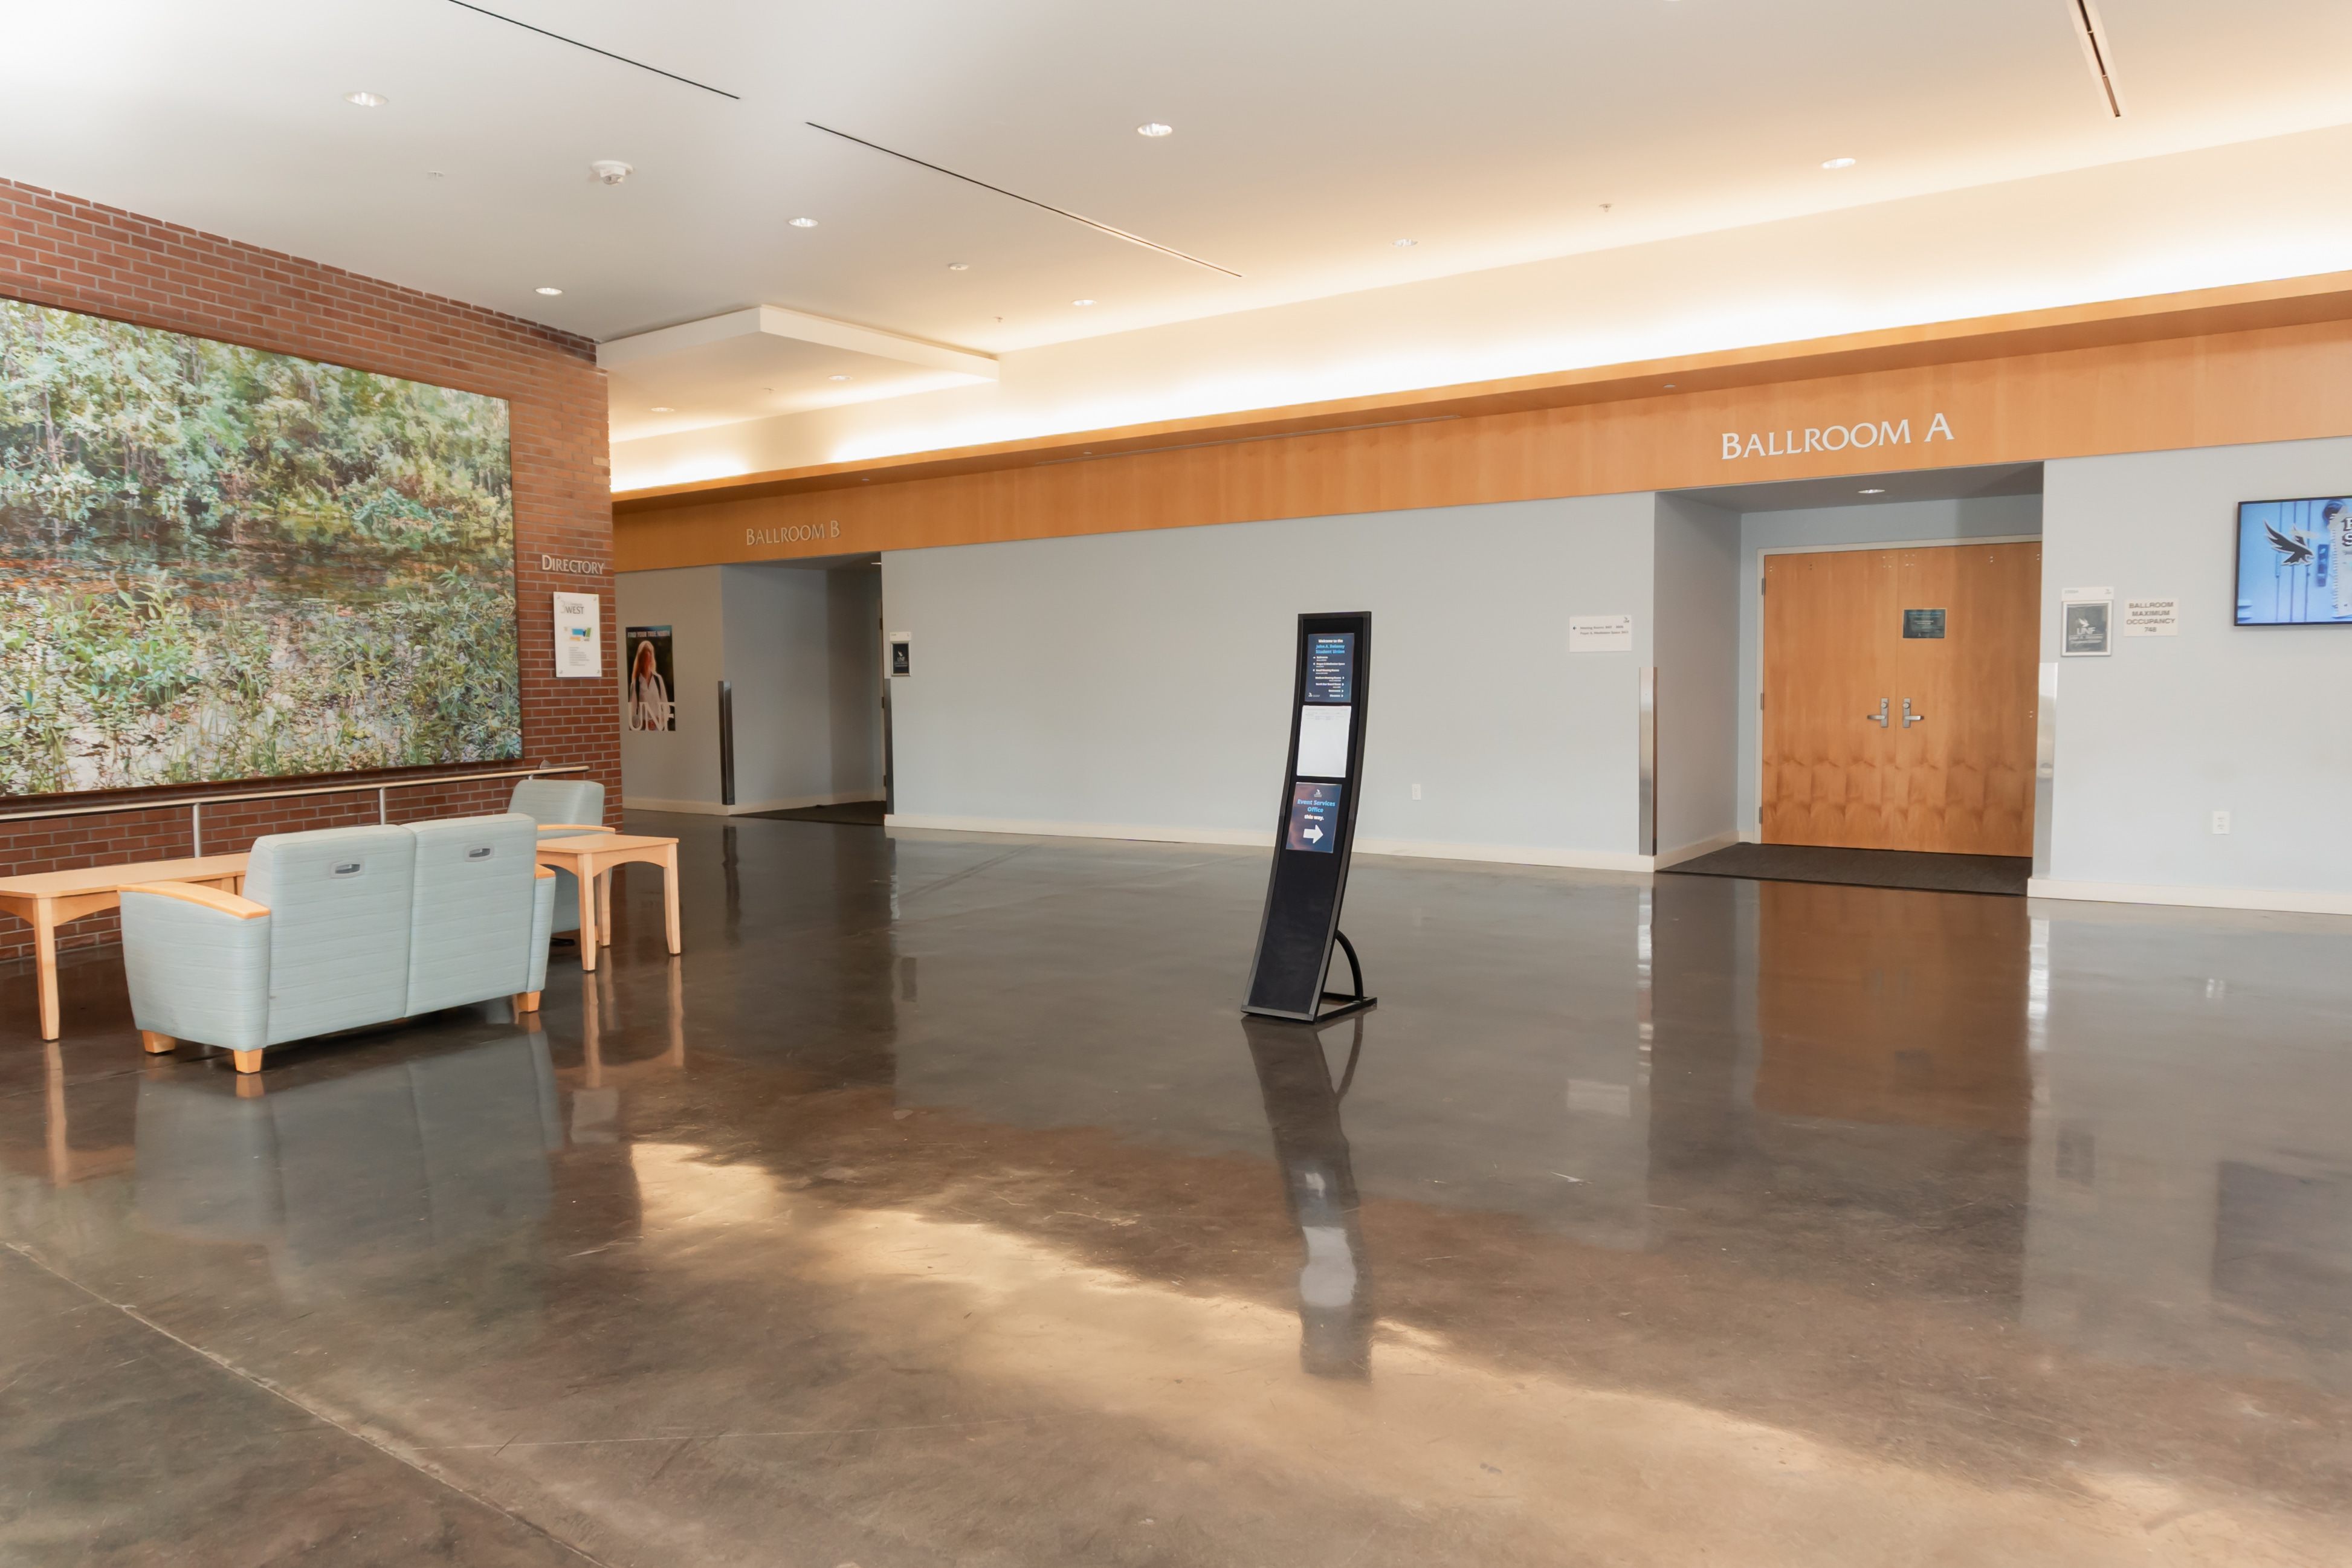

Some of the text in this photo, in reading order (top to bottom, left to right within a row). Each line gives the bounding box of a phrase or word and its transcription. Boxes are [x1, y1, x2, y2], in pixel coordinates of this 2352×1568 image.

[1722, 413, 1954, 459] BALLROOM A
[746, 520, 841, 546] BALLROOM B
[541, 554, 604, 574] DIRECTORY
[628, 702, 675, 731] UNF
